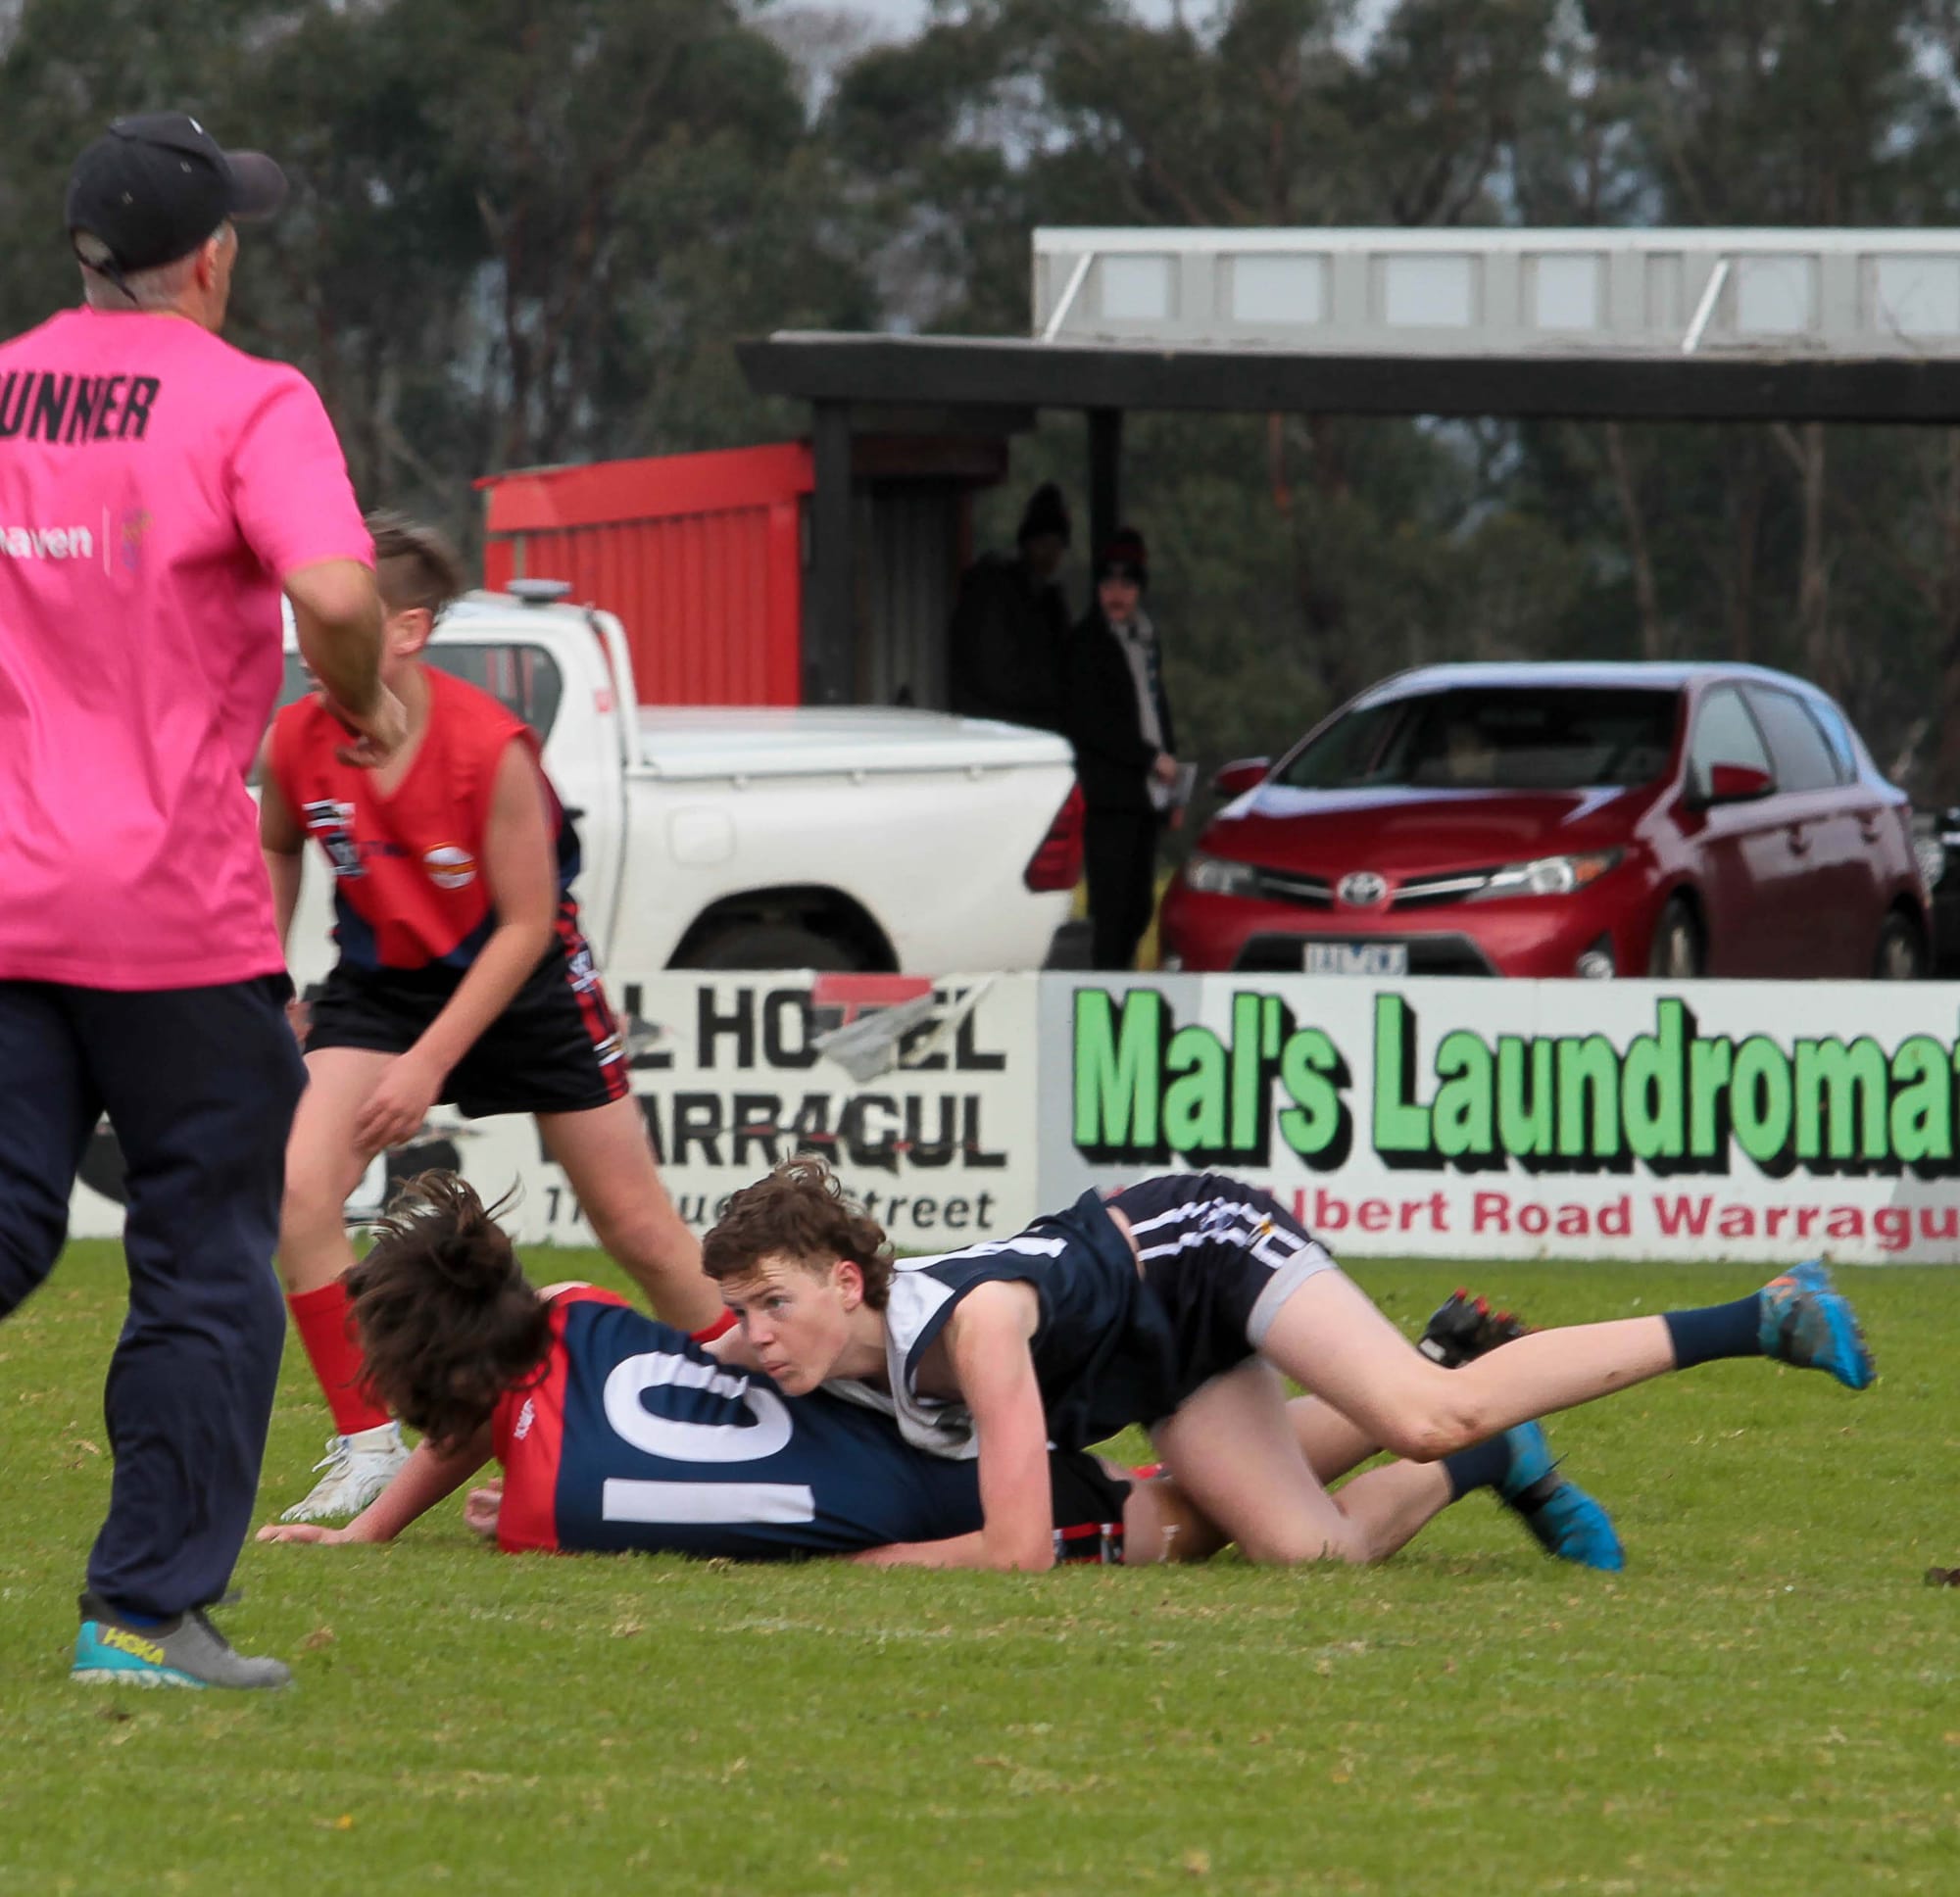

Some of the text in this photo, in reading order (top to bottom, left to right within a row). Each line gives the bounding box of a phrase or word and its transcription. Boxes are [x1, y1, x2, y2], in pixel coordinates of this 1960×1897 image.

[699, 986, 1005, 1070] HOEL
[1074, 988, 1960, 1179] Mal's Laundroma
[841, 1189, 994, 1230] treet
[1258, 1186, 1450, 1233] lbert
[1473, 1191, 1632, 1237] Road
[602, 1350, 815, 1525] 10
[102, 1627, 165, 1666] HOKA
